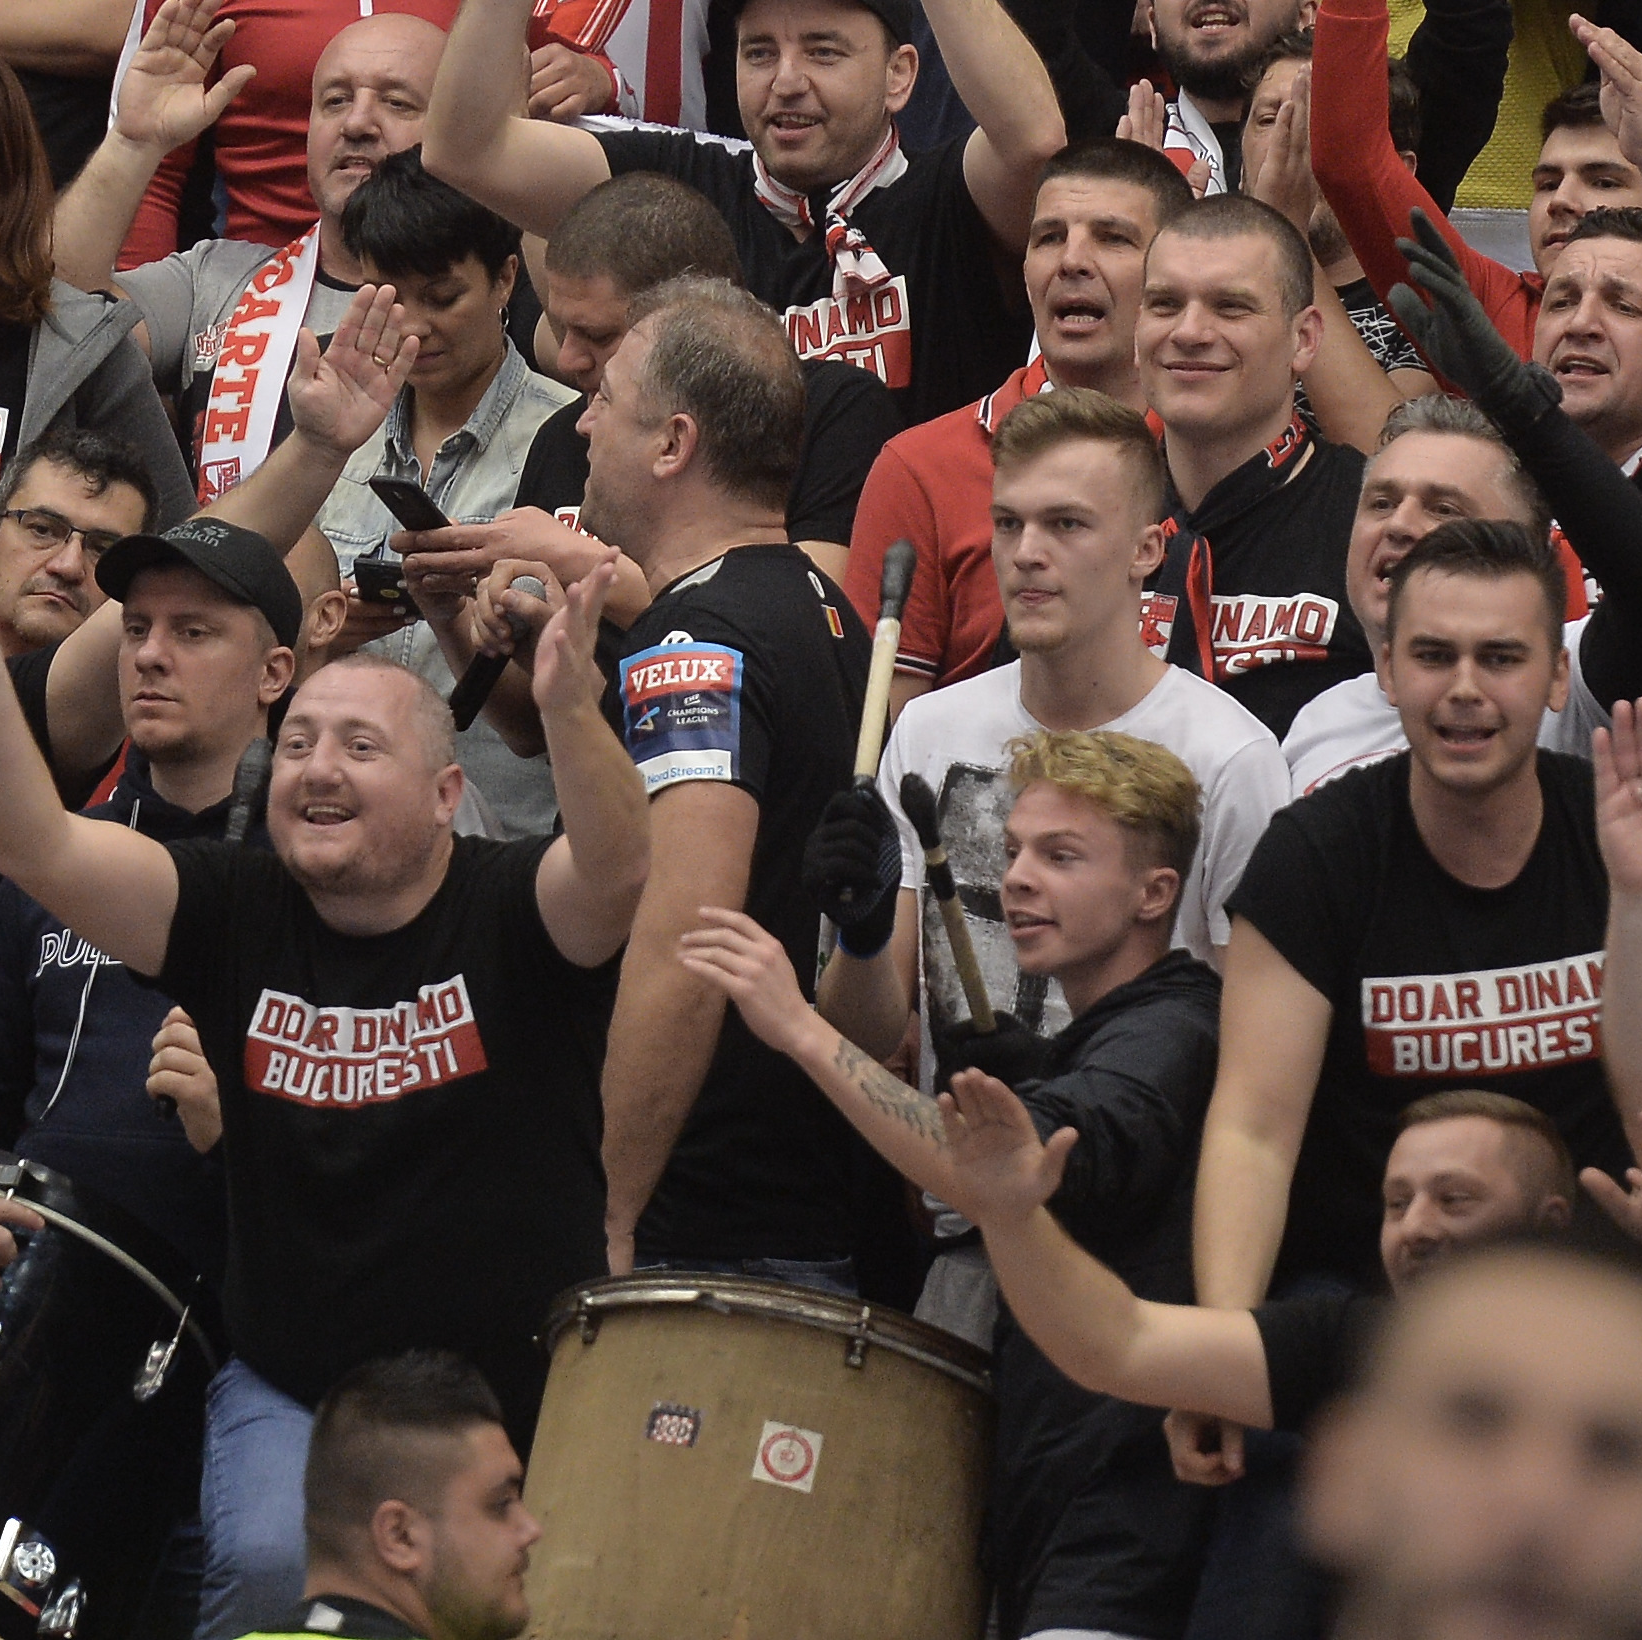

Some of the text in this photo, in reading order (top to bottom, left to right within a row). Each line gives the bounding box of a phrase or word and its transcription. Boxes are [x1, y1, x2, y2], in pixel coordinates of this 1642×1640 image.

[630, 659, 723, 696] VELUX
[667, 705, 719, 717] CHAMPIONS
[676, 715, 709, 725] LEAGUE
[670, 764, 715, 781] Stream
[715, 764, 725, 778] 2
[1371, 961, 1605, 1024] DOAR DINAM
[1392, 1015, 1601, 1074] BUCURES
